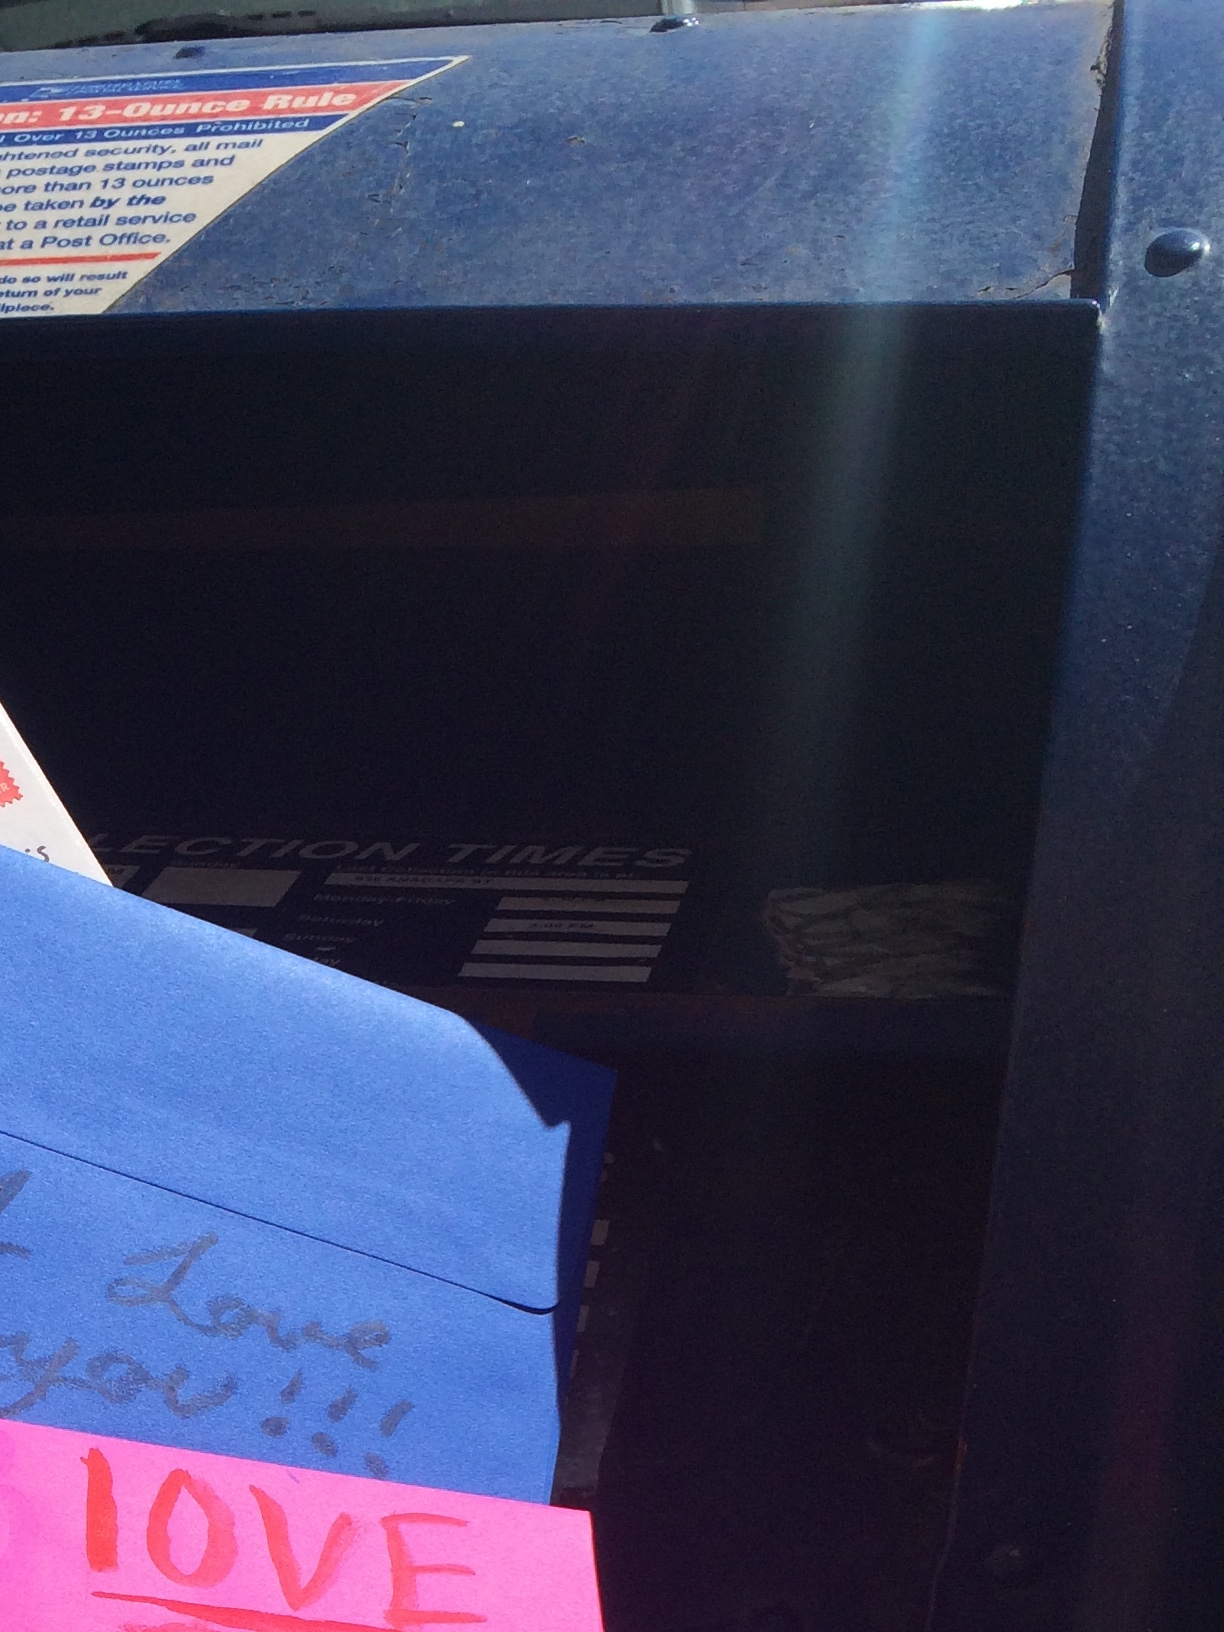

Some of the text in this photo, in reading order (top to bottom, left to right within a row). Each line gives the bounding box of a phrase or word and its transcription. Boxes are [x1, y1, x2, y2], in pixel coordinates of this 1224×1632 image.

[59, 97, 250, 121] 13-Ounce
[263, 91, 358, 110] Rule
[14, 131, 64, 143] Over
[75, 129, 96, 140] 13
[100, 125, 185, 138] Ounces
[196, 118, 310, 134] Prohibited
[84, 142, 177, 158] security,
[184, 140, 210, 152] all
[215, 138, 264, 150] mail
[7, 161, 97, 179] postage
[102, 159, 185, 175] stamps
[192, 155, 235, 167] and
[43, 180, 92, 194] than
[100, 177, 125, 190] 13
[131, 173, 214, 188] ounces
[23, 197, 85, 212] taken
[90, 196, 121, 211] by
[126, 192, 167, 206] the
[6, 218, 29, 232] to
[34, 219, 48, 229] a
[53, 213, 110, 229] retail
[116, 210, 196, 225] service
[20, 239, 34, 250] a
[40, 234, 94, 249] Post
[99, 230, 171, 246] Office.
[22, 275, 42, 284] so
[47, 271, 75, 283] will
[79, 269, 128, 282] result
[43, 286, 60, 297] of
[64, 286, 102, 299] your
[446, 843, 695, 870] TIMES
